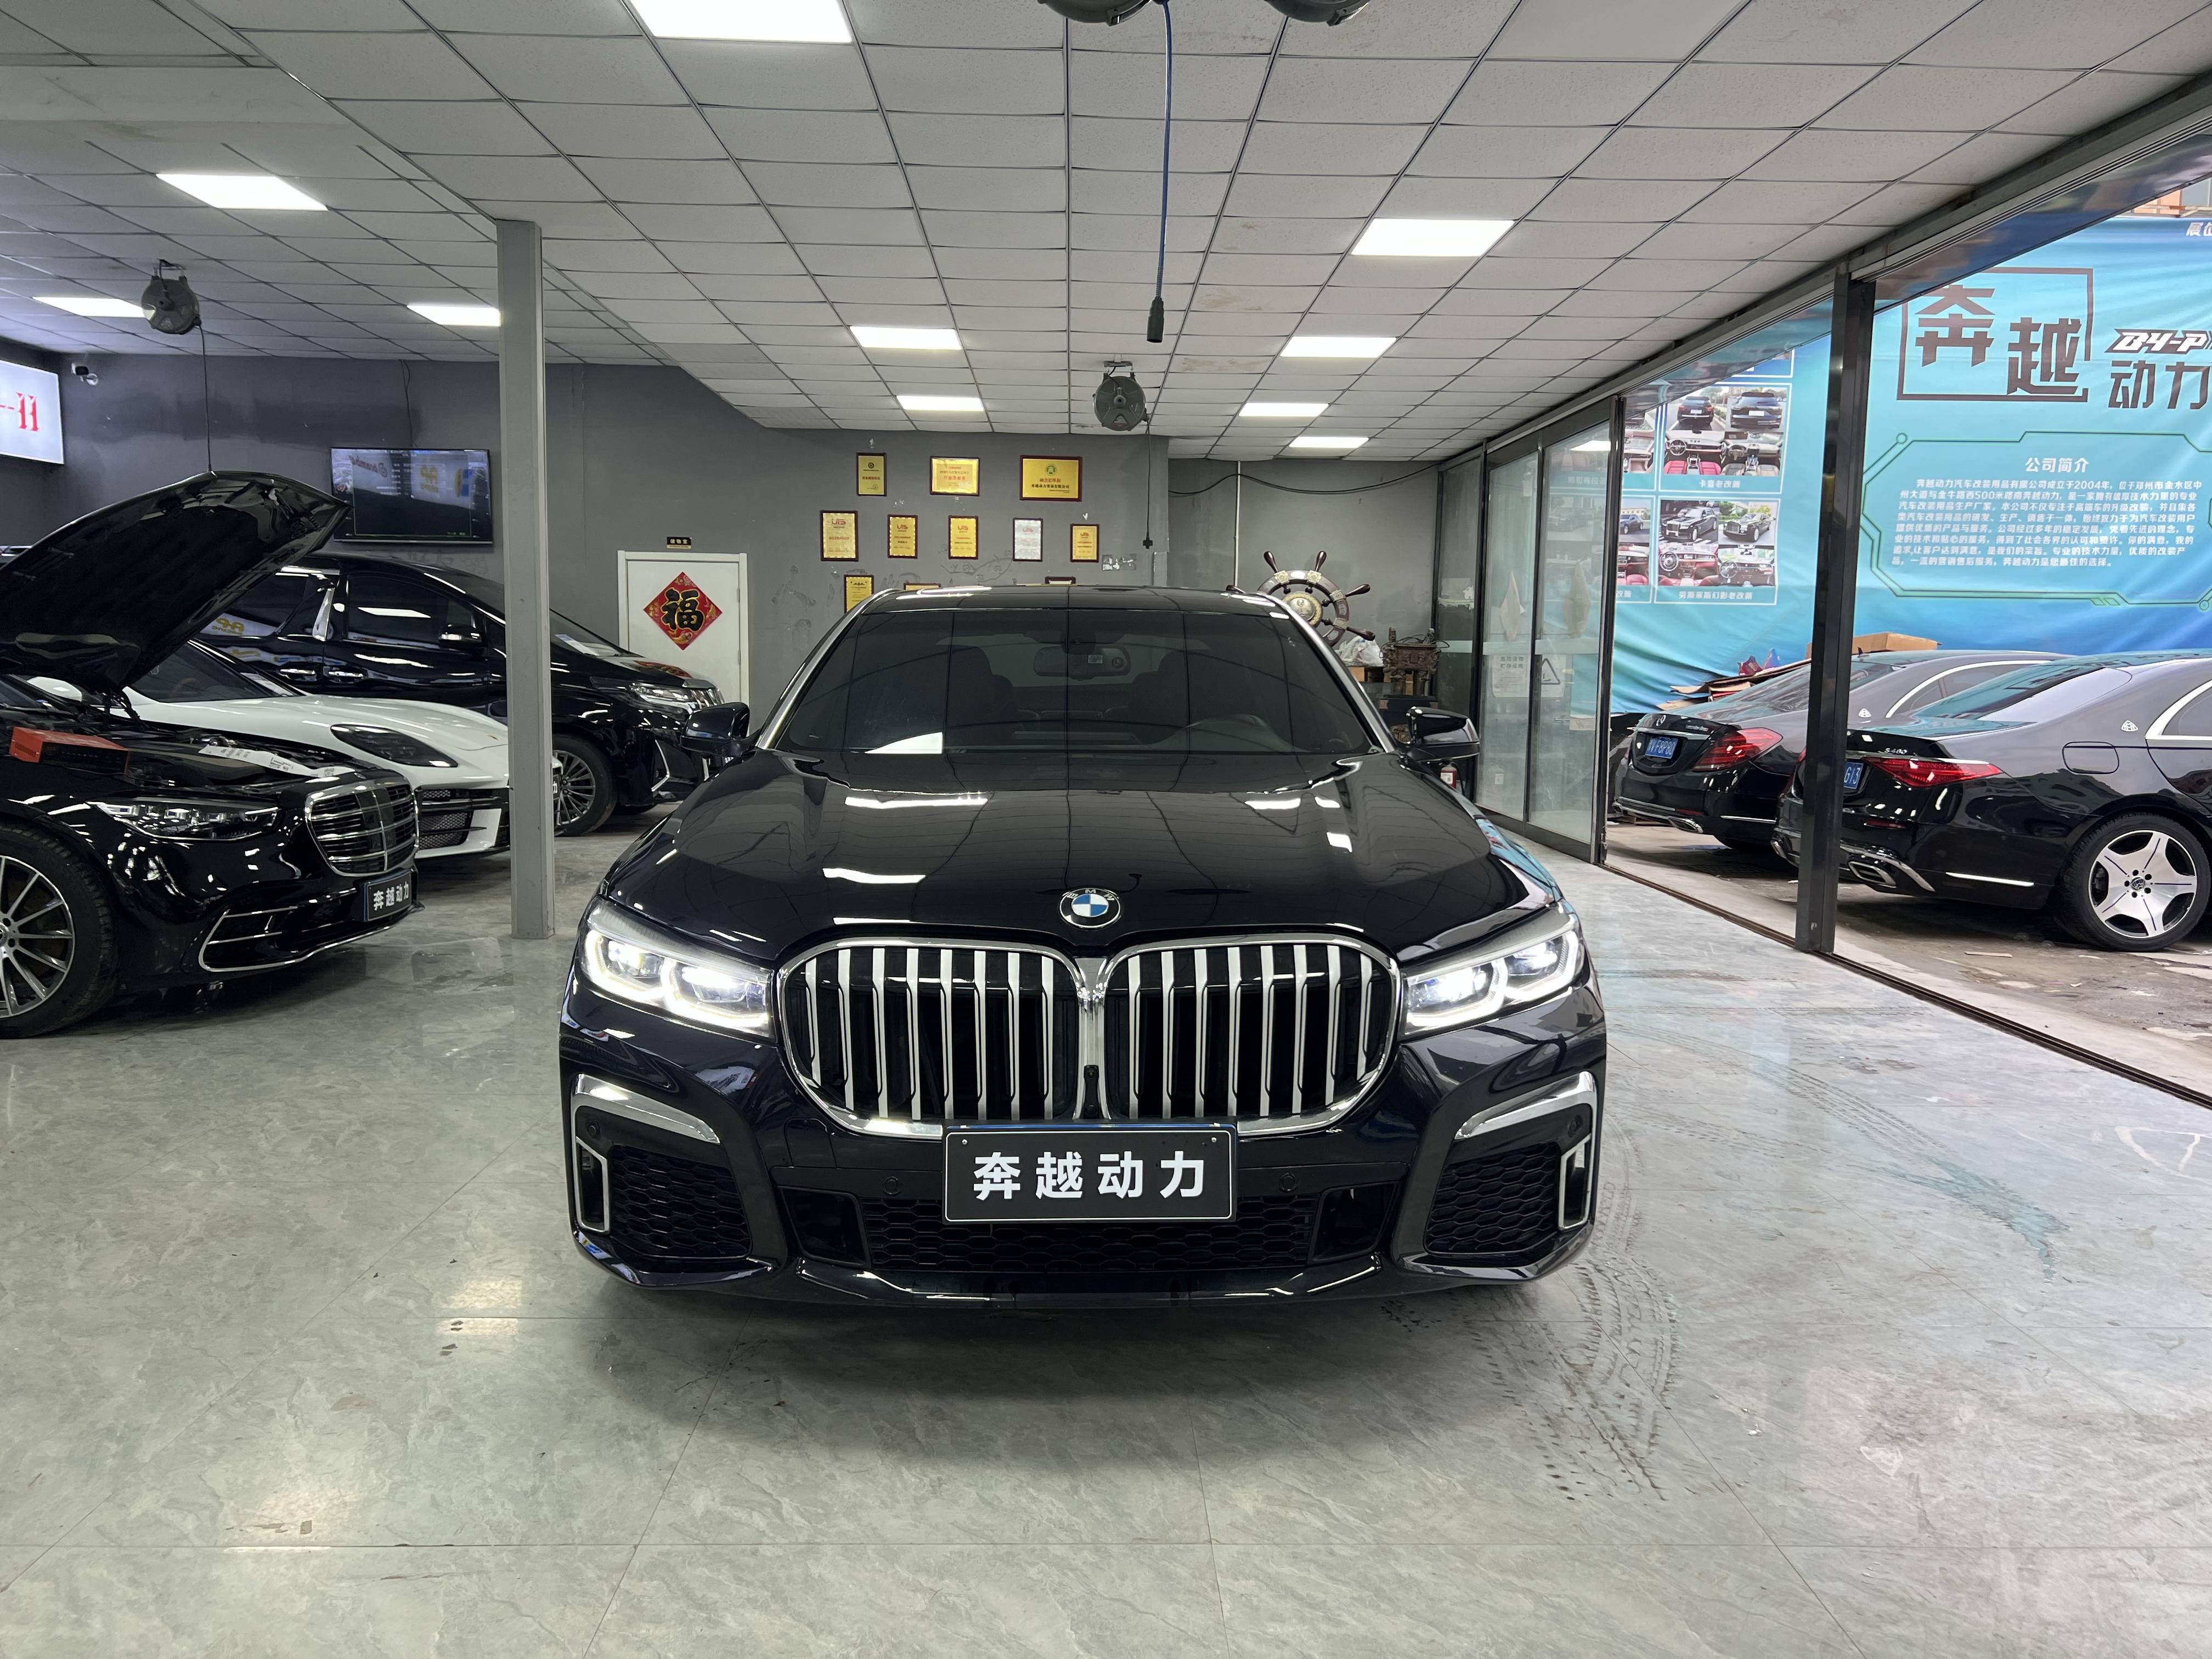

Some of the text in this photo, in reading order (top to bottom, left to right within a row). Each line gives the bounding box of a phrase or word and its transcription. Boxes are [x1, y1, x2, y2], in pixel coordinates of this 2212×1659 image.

[2025, 457, 2089, 473] 公司简介
[661, 587, 705, 632] 福
[373, 881, 409, 911] 奔越动力
[1066, 889, 1115, 901] BMW
[973, 1150, 1204, 1200] 奔越动力
